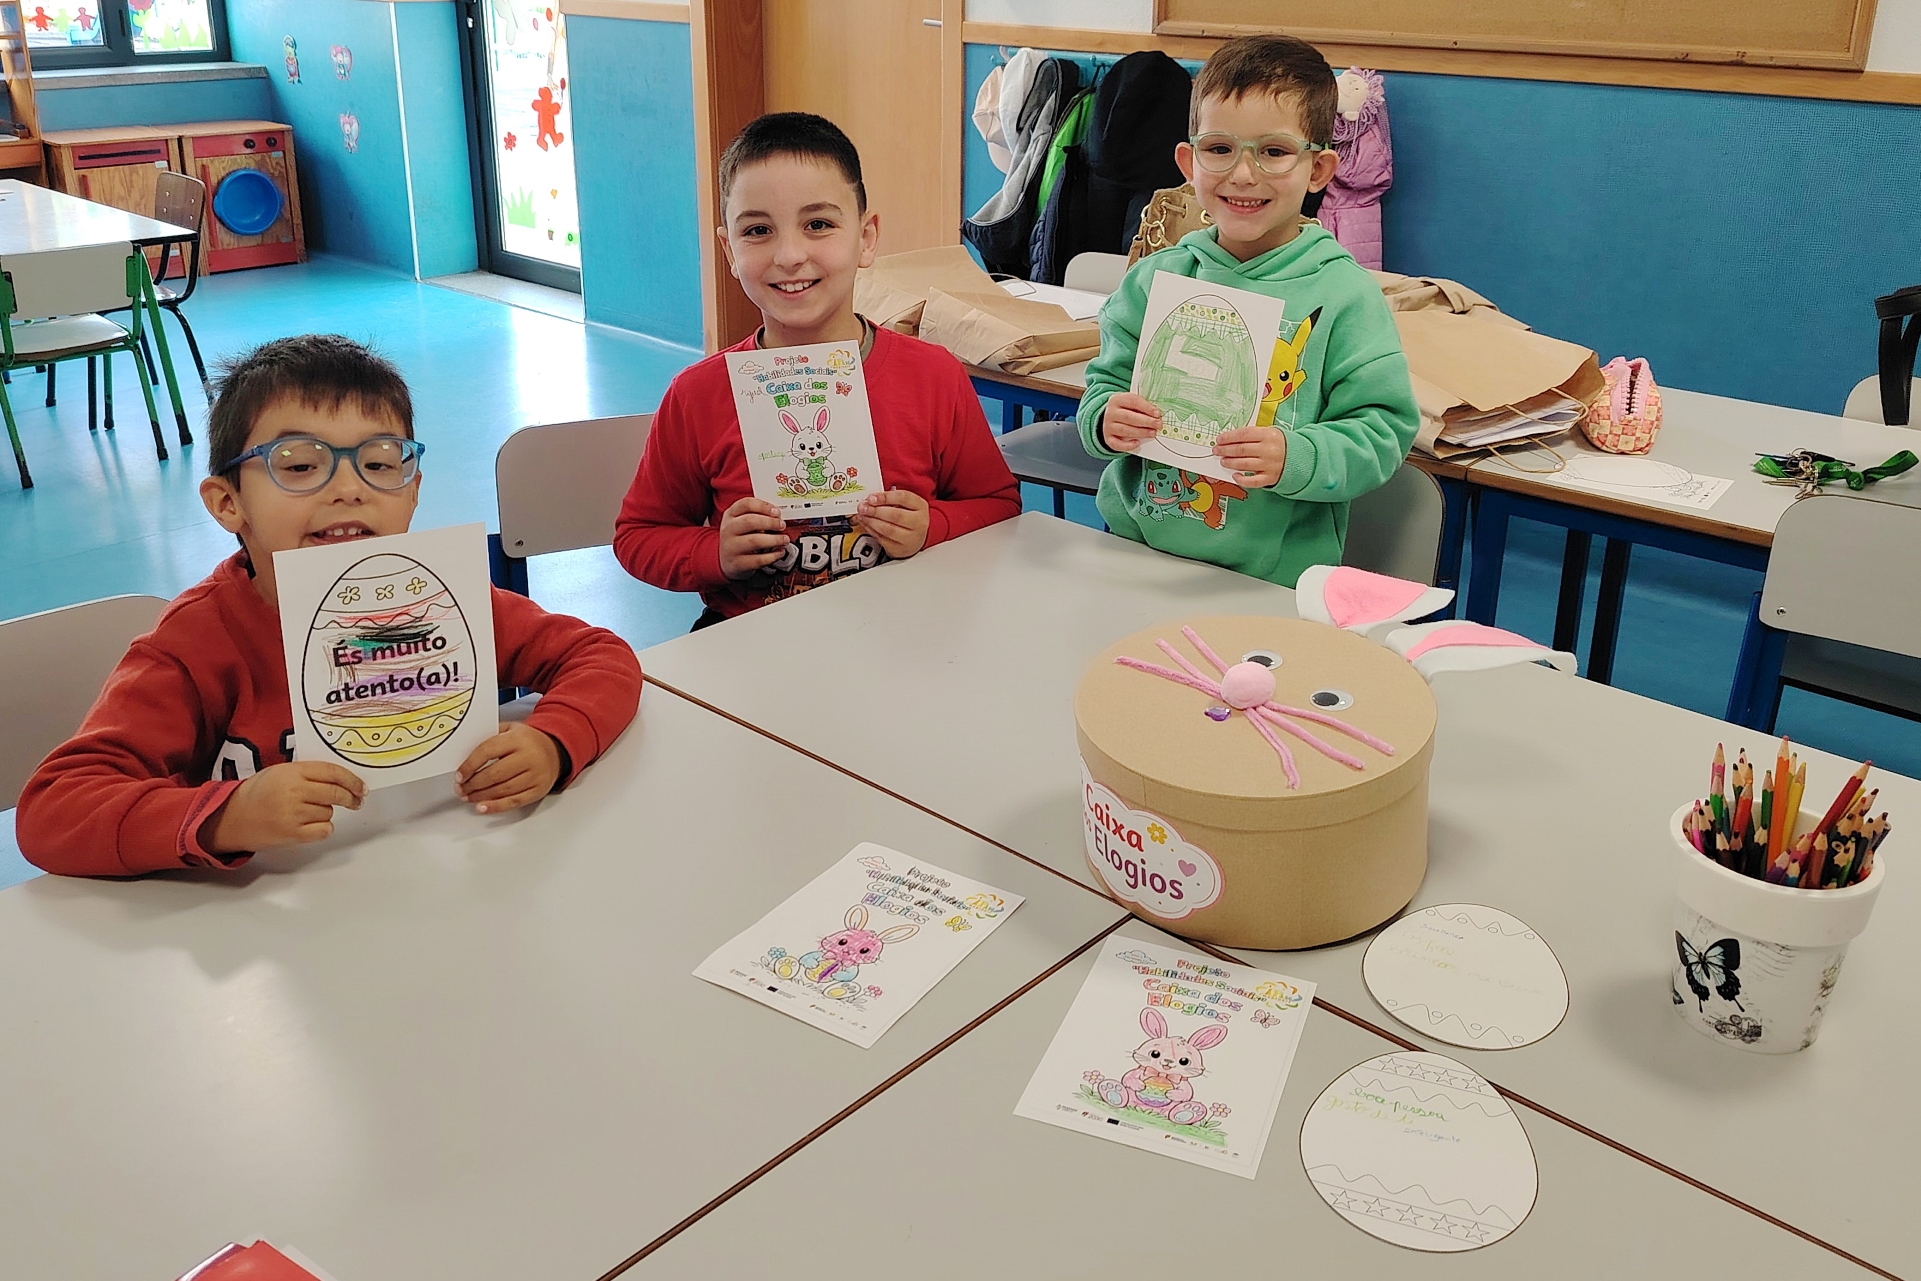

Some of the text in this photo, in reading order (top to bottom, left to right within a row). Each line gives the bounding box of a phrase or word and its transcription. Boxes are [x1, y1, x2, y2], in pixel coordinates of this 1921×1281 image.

[774, 355, 809, 366] Projeto
[766, 377, 828, 395] Caixa dos
[773, 392, 827, 408] Elogios
[332, 632, 447, 668] És muito
[325, 661, 460, 705] atento(a)!
[1086, 783, 1145, 852] Caixa
[1094, 823, 1184, 900] Elogios
[866, 881, 915, 903] Caixa
[1176, 958, 1231, 979] Projeto
[1143, 978, 1201, 1000] Caixa
[1204, 991, 1244, 1012] dos
[1147, 992, 1232, 1024] Elogios
